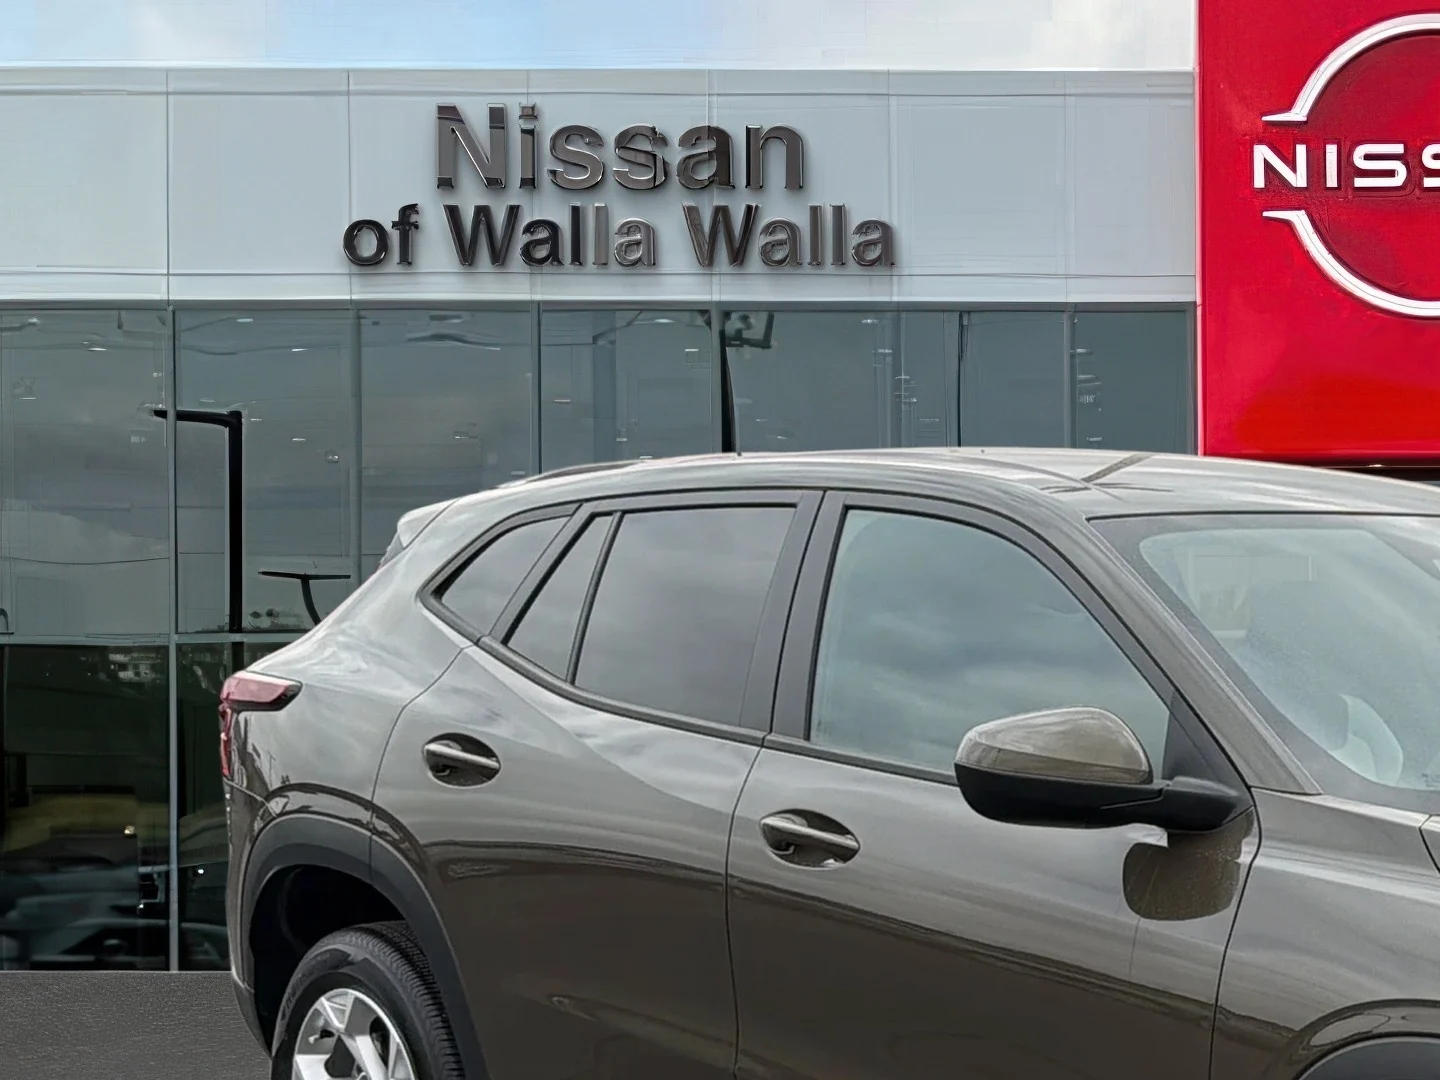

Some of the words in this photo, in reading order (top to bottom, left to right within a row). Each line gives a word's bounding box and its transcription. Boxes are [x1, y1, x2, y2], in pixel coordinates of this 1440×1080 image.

[436, 102, 804, 190] Nissan
[342, 203, 421, 267] of
[443, 203, 657, 267] Walla
[681, 203, 897, 267] Walla
